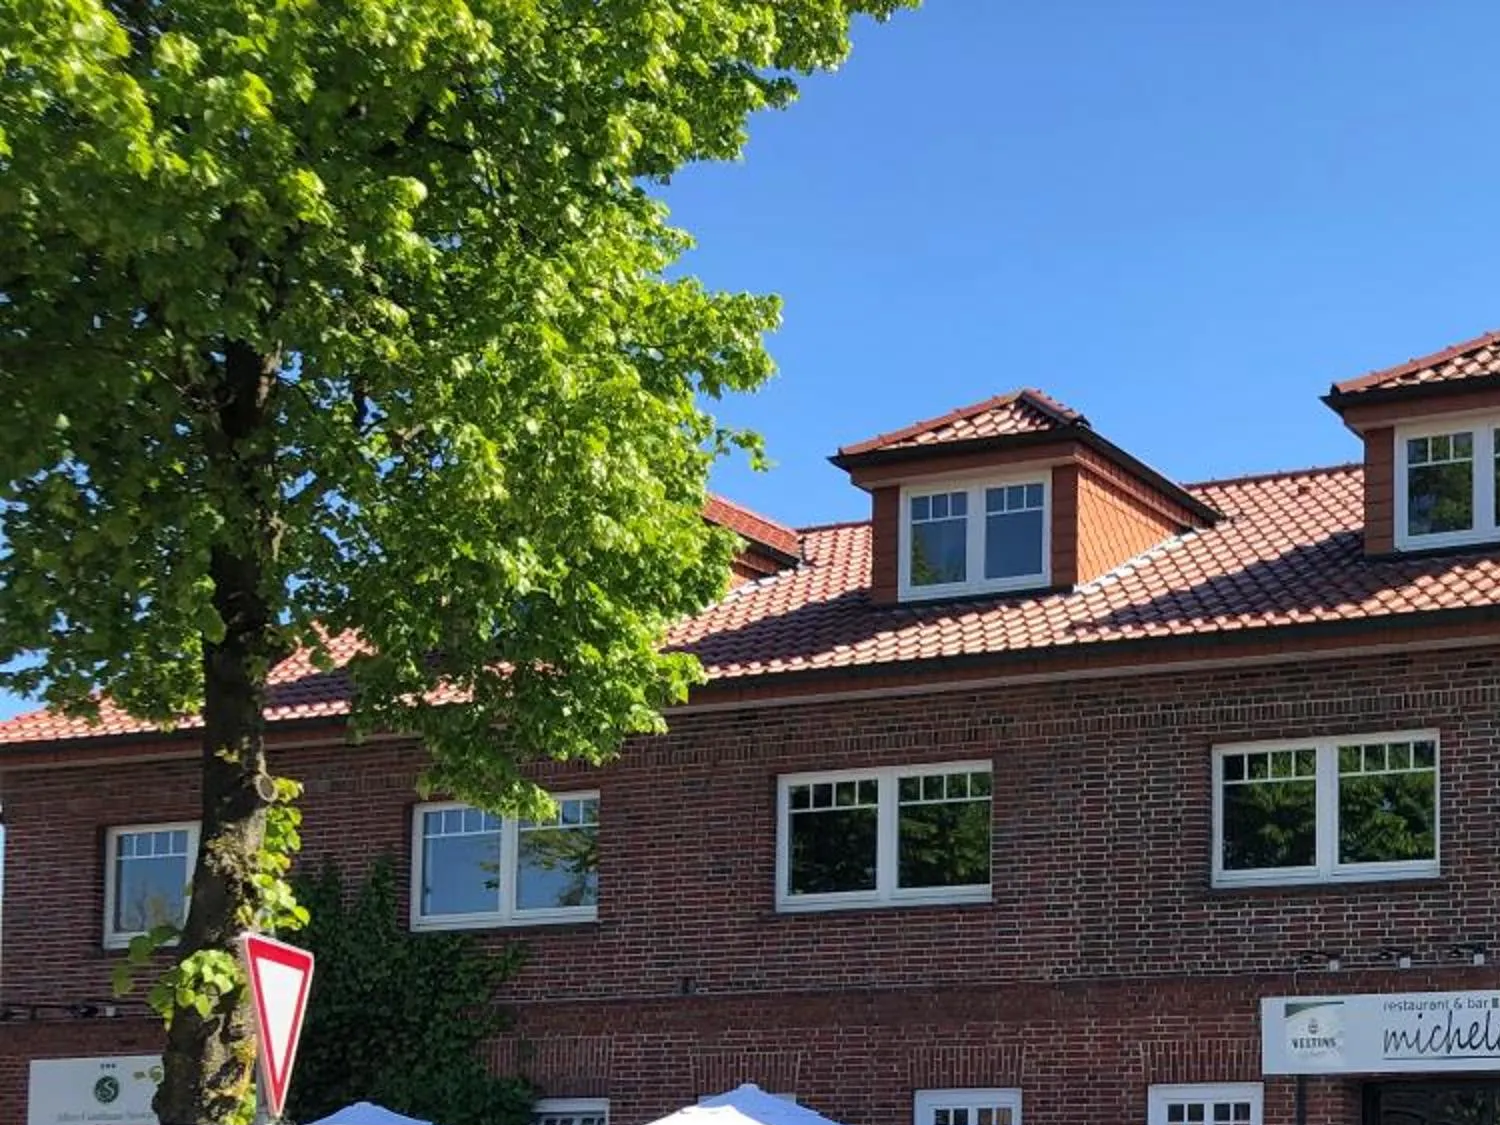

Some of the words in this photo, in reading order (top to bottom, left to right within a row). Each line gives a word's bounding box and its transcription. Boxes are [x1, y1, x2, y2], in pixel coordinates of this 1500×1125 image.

[1383, 998, 1449, 1012] restaurant
[1467, 996, 1489, 1009] bar
[1291, 1037, 1337, 1049] VELTINS
